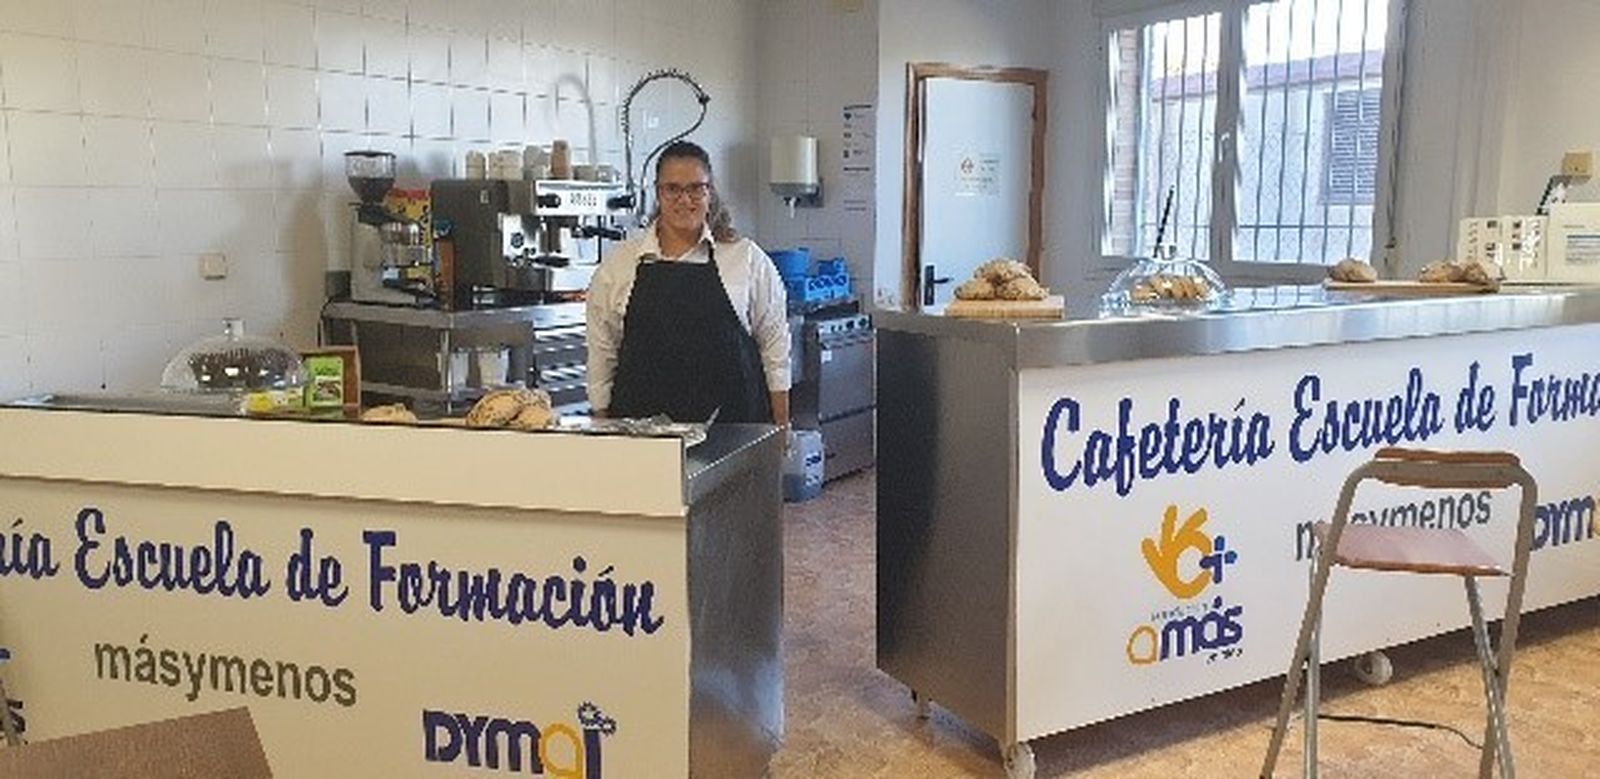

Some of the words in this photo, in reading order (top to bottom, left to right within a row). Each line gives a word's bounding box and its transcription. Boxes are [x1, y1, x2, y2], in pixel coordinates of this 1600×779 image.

[1041, 397, 1276, 496] Cafetería
[1289, 367, 1446, 463] Escuela
[1454, 360, 1496, 433] de
[74, 507, 271, 599] Escuela
[285, 528, 349, 606] de
[362, 530, 665, 636] Formación
[94, 633, 357, 706] másymenos
